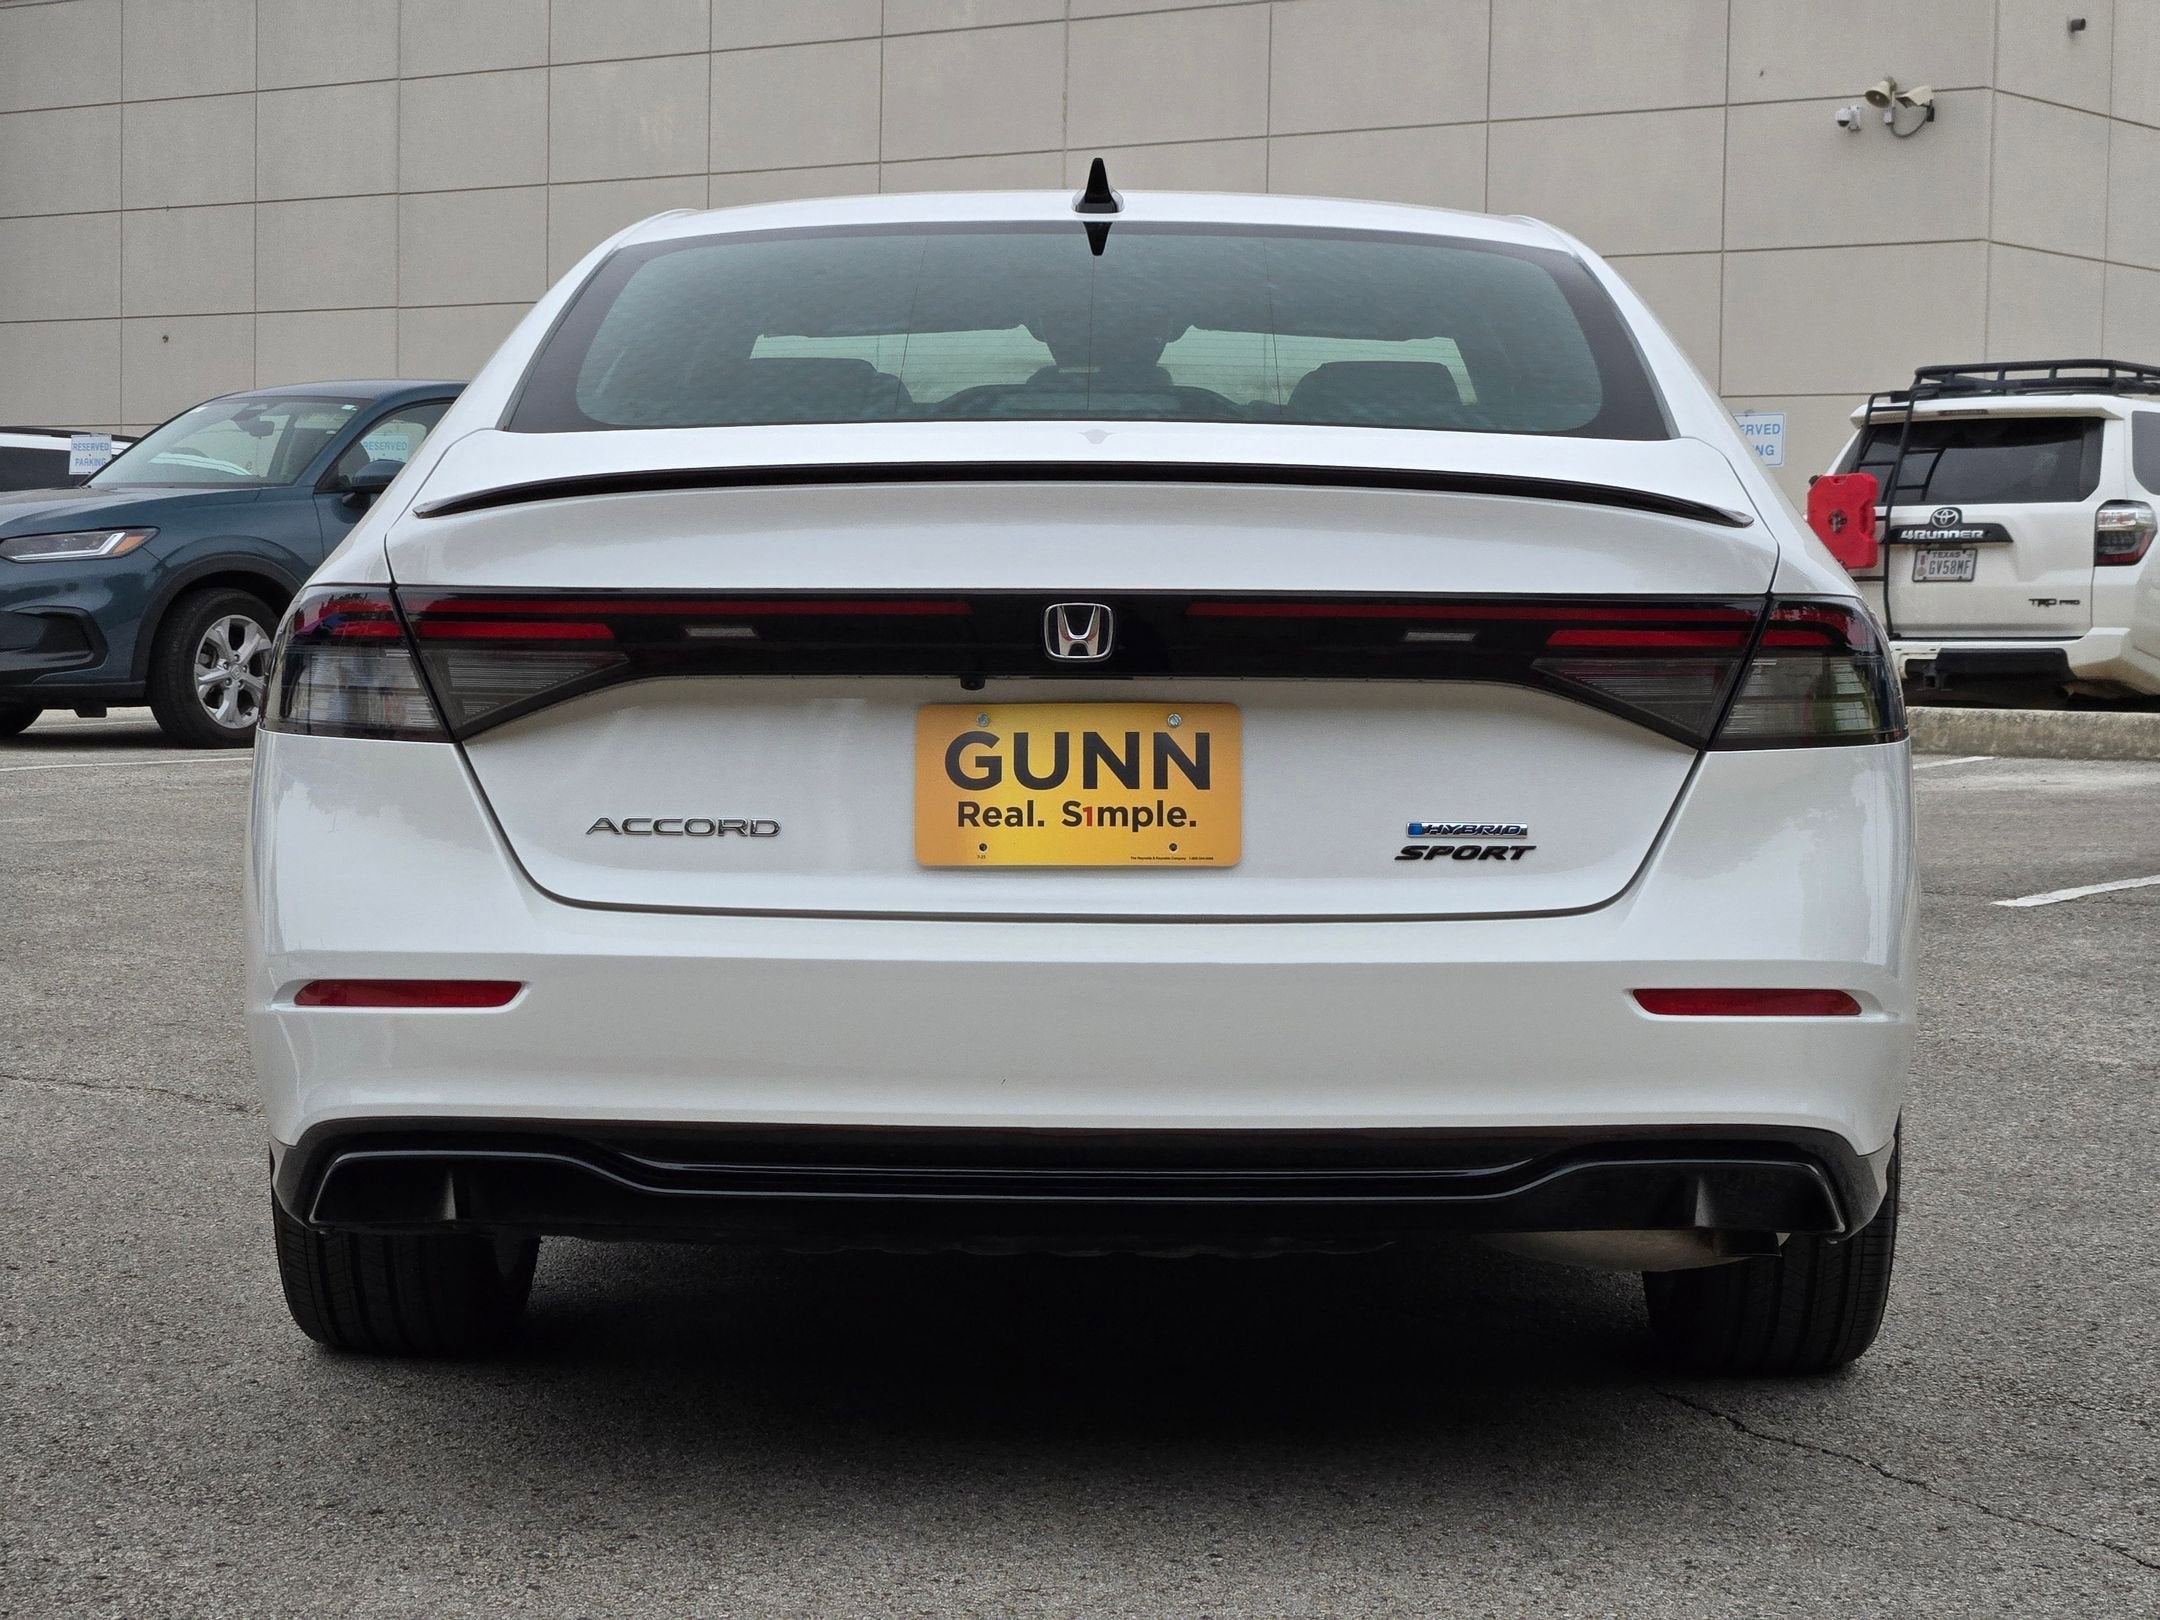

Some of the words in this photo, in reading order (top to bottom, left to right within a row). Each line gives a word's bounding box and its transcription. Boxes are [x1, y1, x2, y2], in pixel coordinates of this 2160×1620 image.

[73, 442, 110, 451] RESERVED
[1901, 529, 1984, 540] 4RUNNER
[944, 731, 1211, 791] GUNN
[957, 800, 1046, 828] Real.
[1061, 800, 1198, 833] S1mple.
[586, 817, 782, 838] ACCORD
[1422, 823, 1522, 836] HYBRID
[1394, 845, 1537, 861] SPORT
